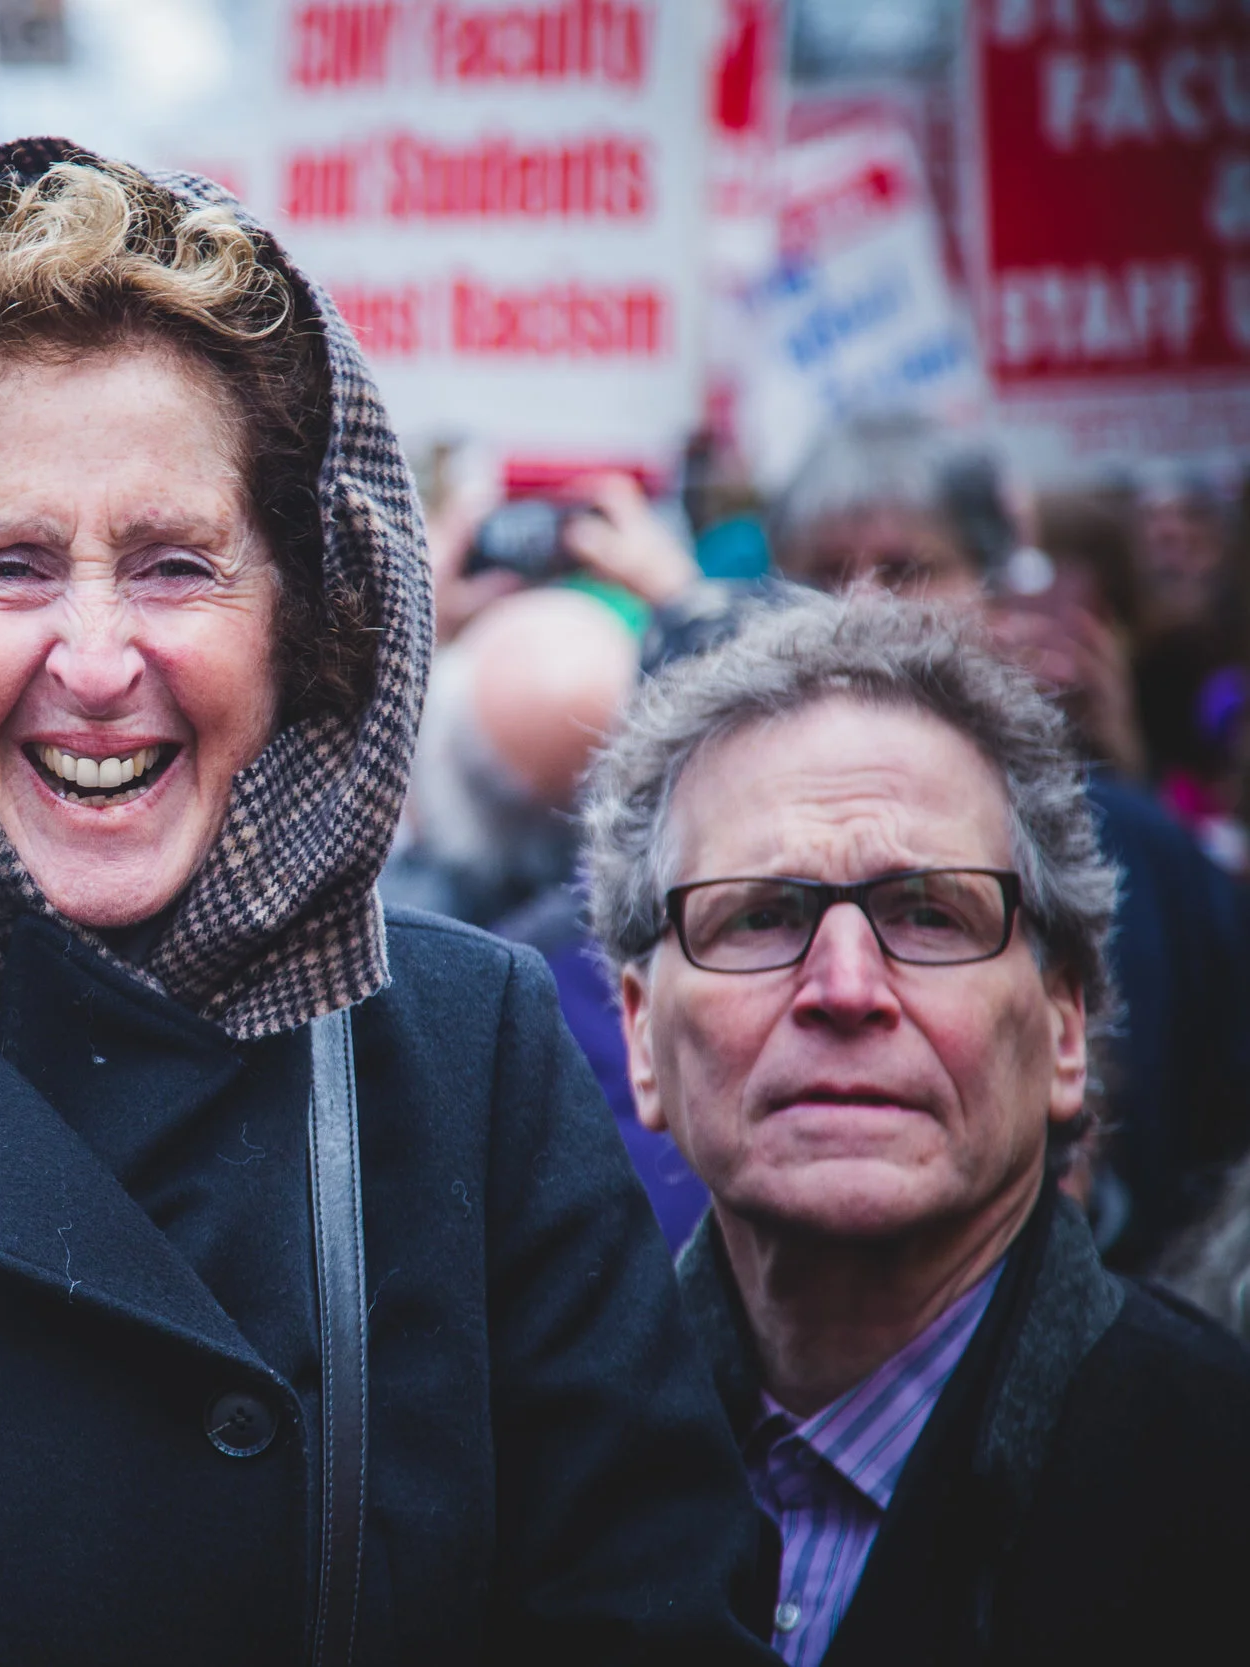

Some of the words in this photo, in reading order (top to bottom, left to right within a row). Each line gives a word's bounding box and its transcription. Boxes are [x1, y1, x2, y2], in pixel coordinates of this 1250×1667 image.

[374, 128, 646, 222] Students
[450, 278, 664, 360] Racism
[996, 264, 1198, 368] STAFF
